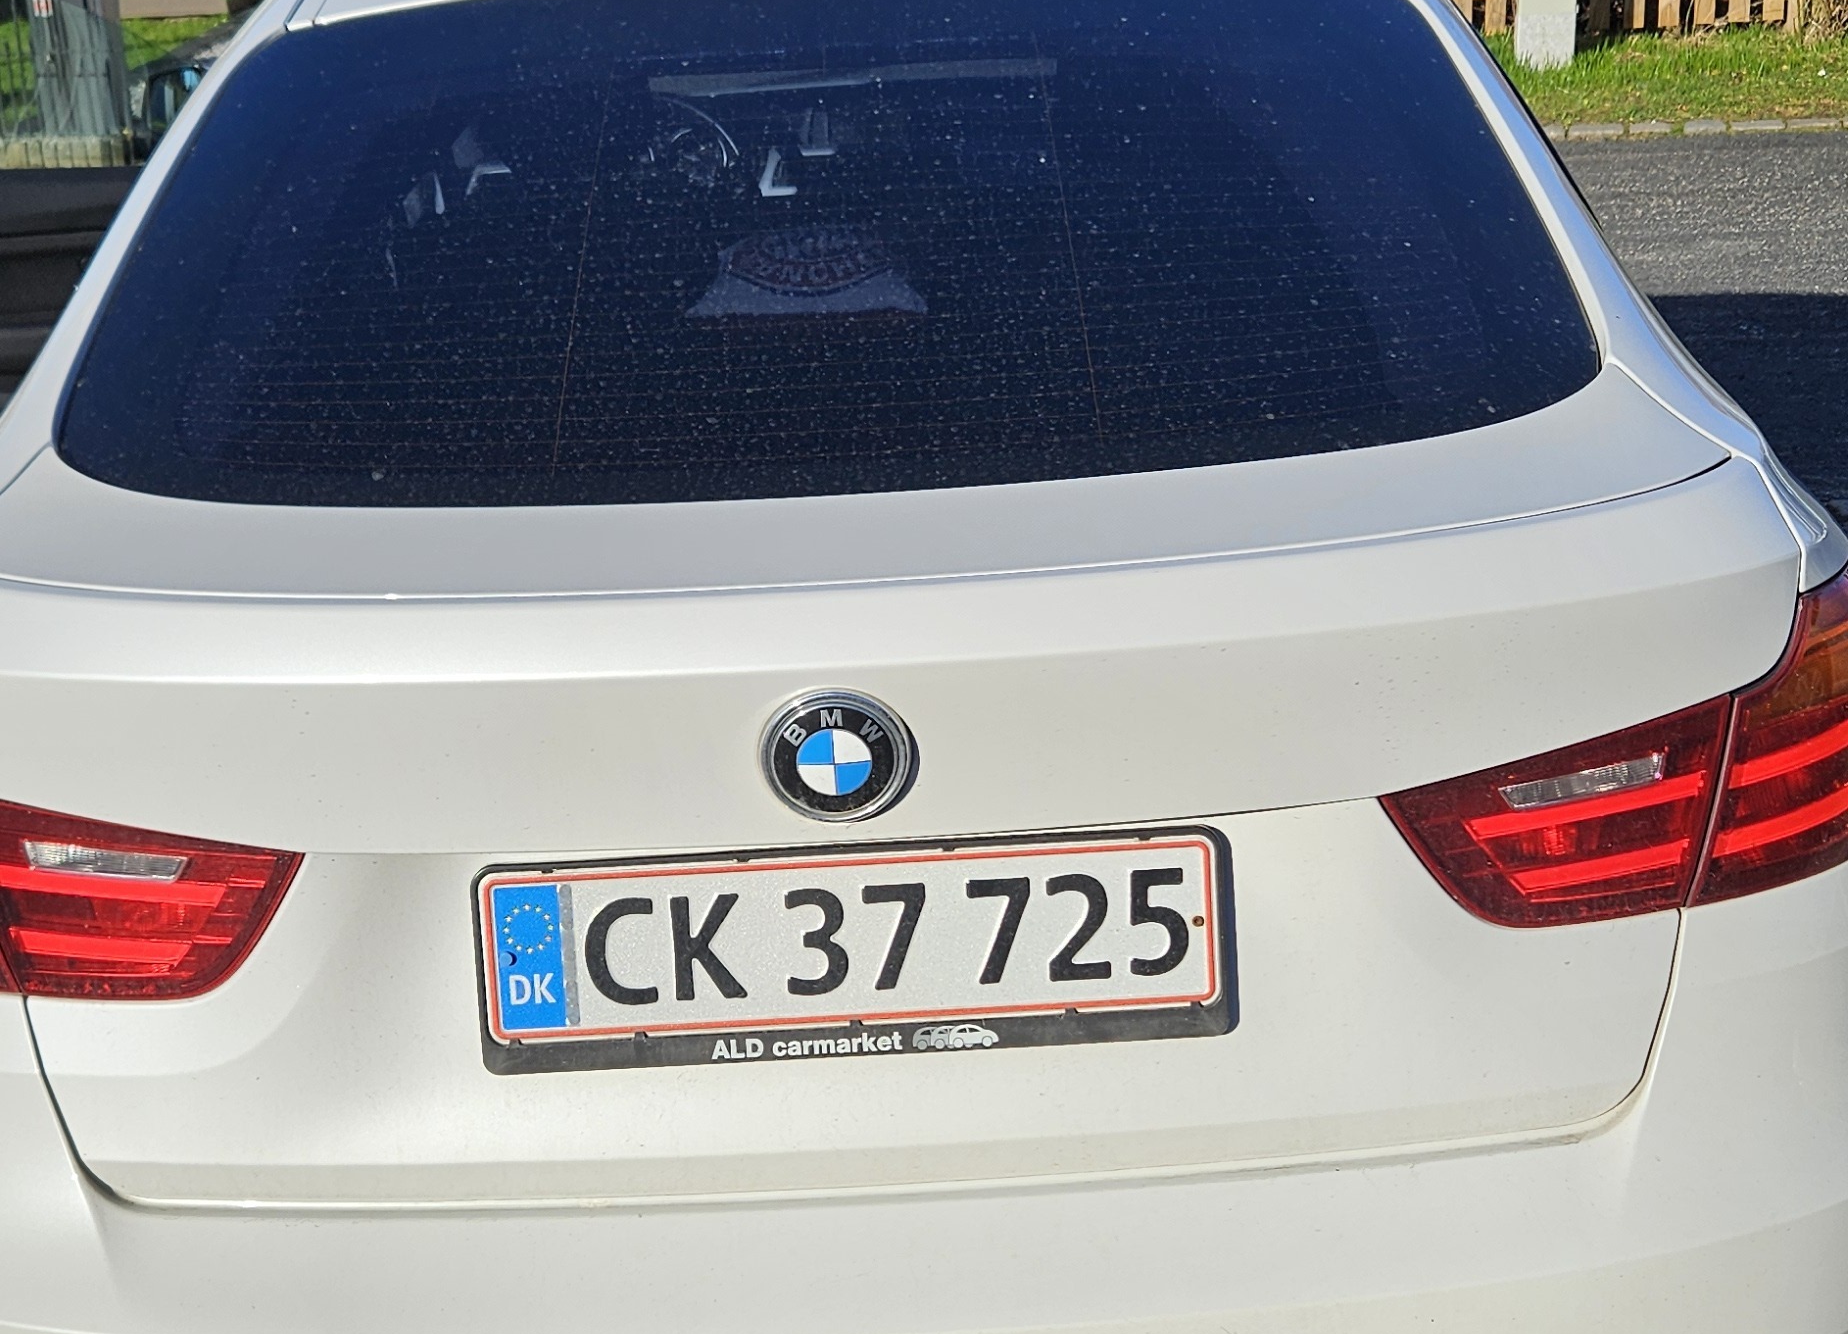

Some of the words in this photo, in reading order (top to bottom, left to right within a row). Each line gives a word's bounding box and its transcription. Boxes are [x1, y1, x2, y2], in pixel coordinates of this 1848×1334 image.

[783, 708, 884, 747] BMW
[584, 893, 748, 1005] CK
[784, 882, 925, 995] 37
[966, 867, 1189, 985] 725
[509, 973, 556, 1005] DK
[711, 1038, 764, 1059] ALD
[772, 1032, 902, 1056] carmarket
